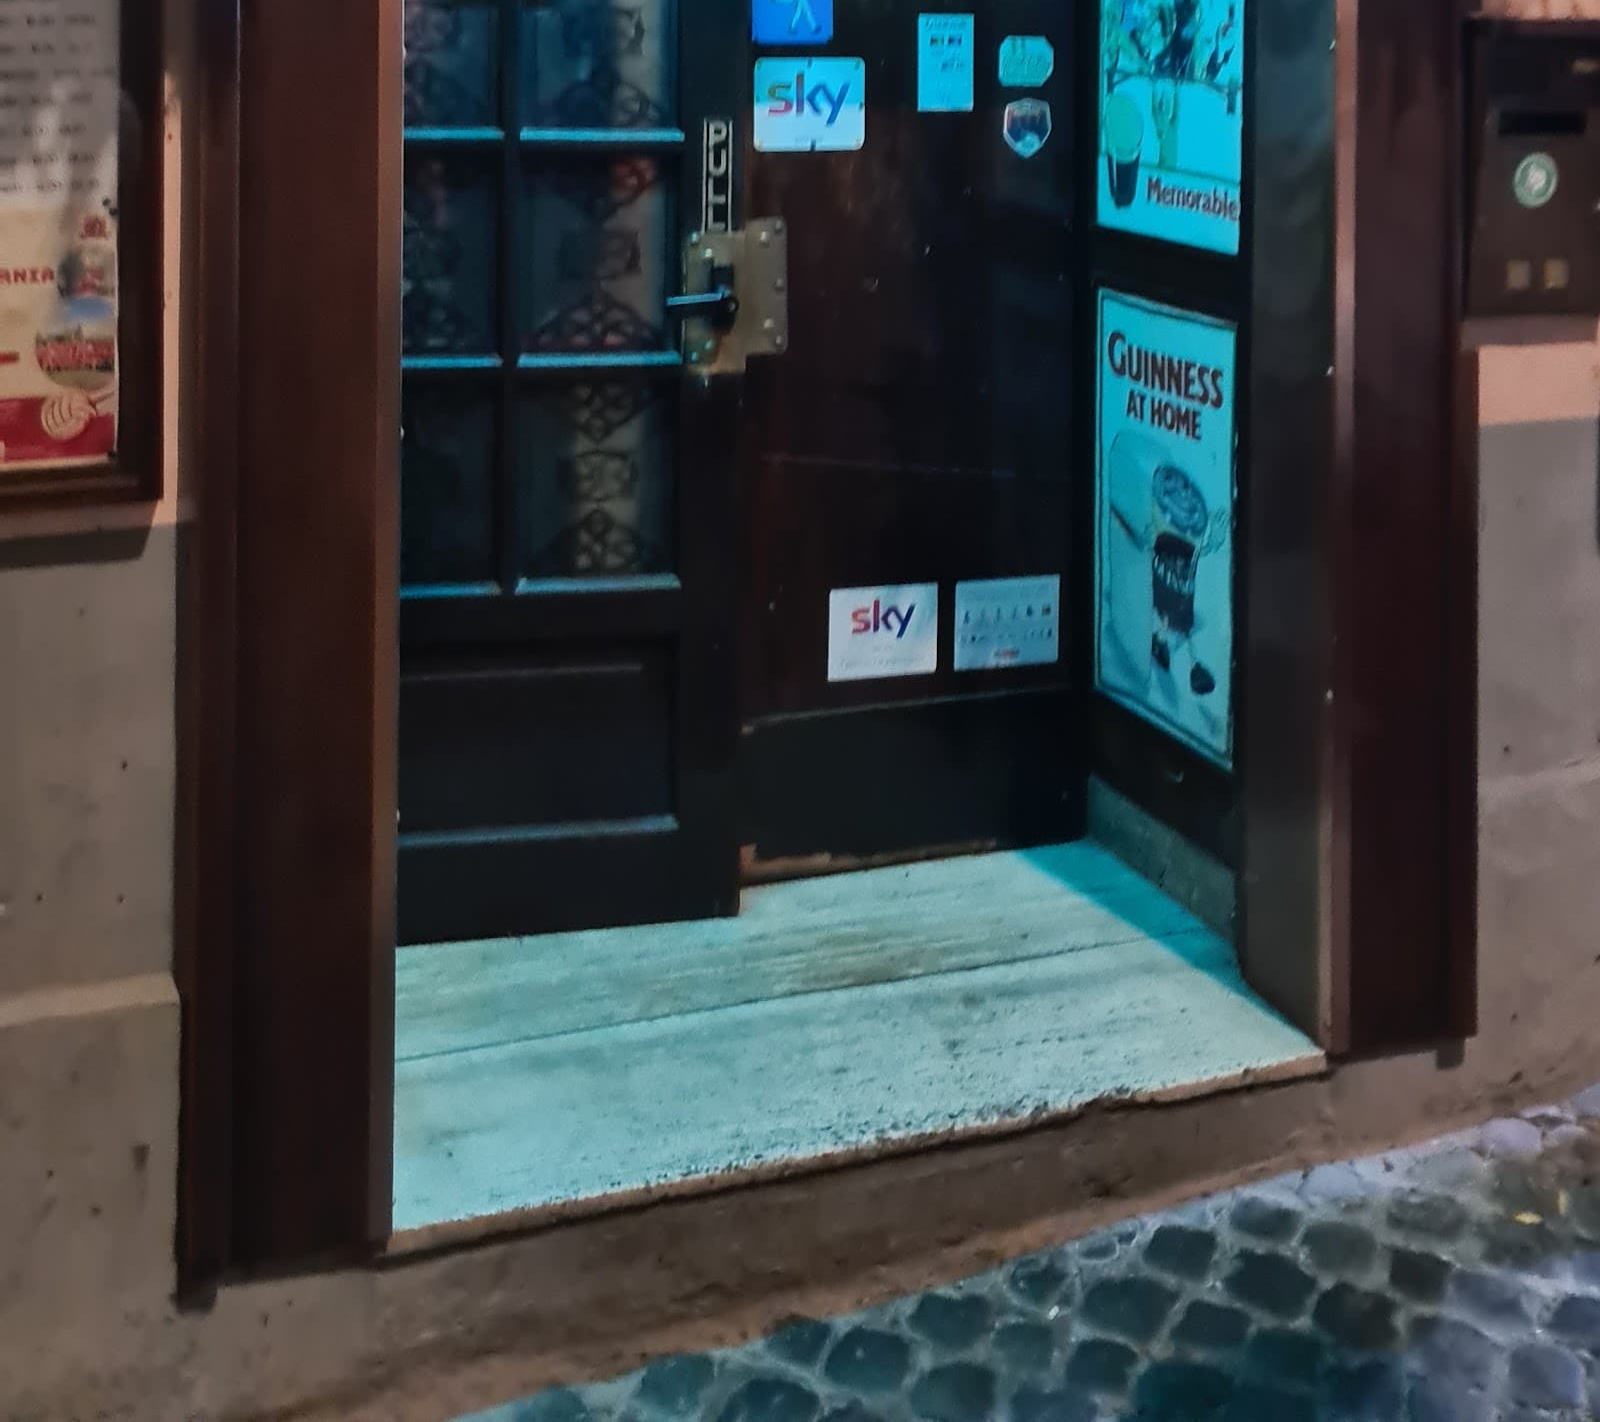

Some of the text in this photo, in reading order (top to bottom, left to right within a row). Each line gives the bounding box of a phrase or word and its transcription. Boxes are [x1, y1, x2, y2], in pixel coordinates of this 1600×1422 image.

[766, 71, 851, 127] sky
[707, 119, 728, 232] PULL
[1146, 175, 1241, 223] Memorable
[1107, 328, 1225, 410] GUINNESS
[1126, 388, 1203, 442] AT HOME
[850, 596, 917, 640] sky
